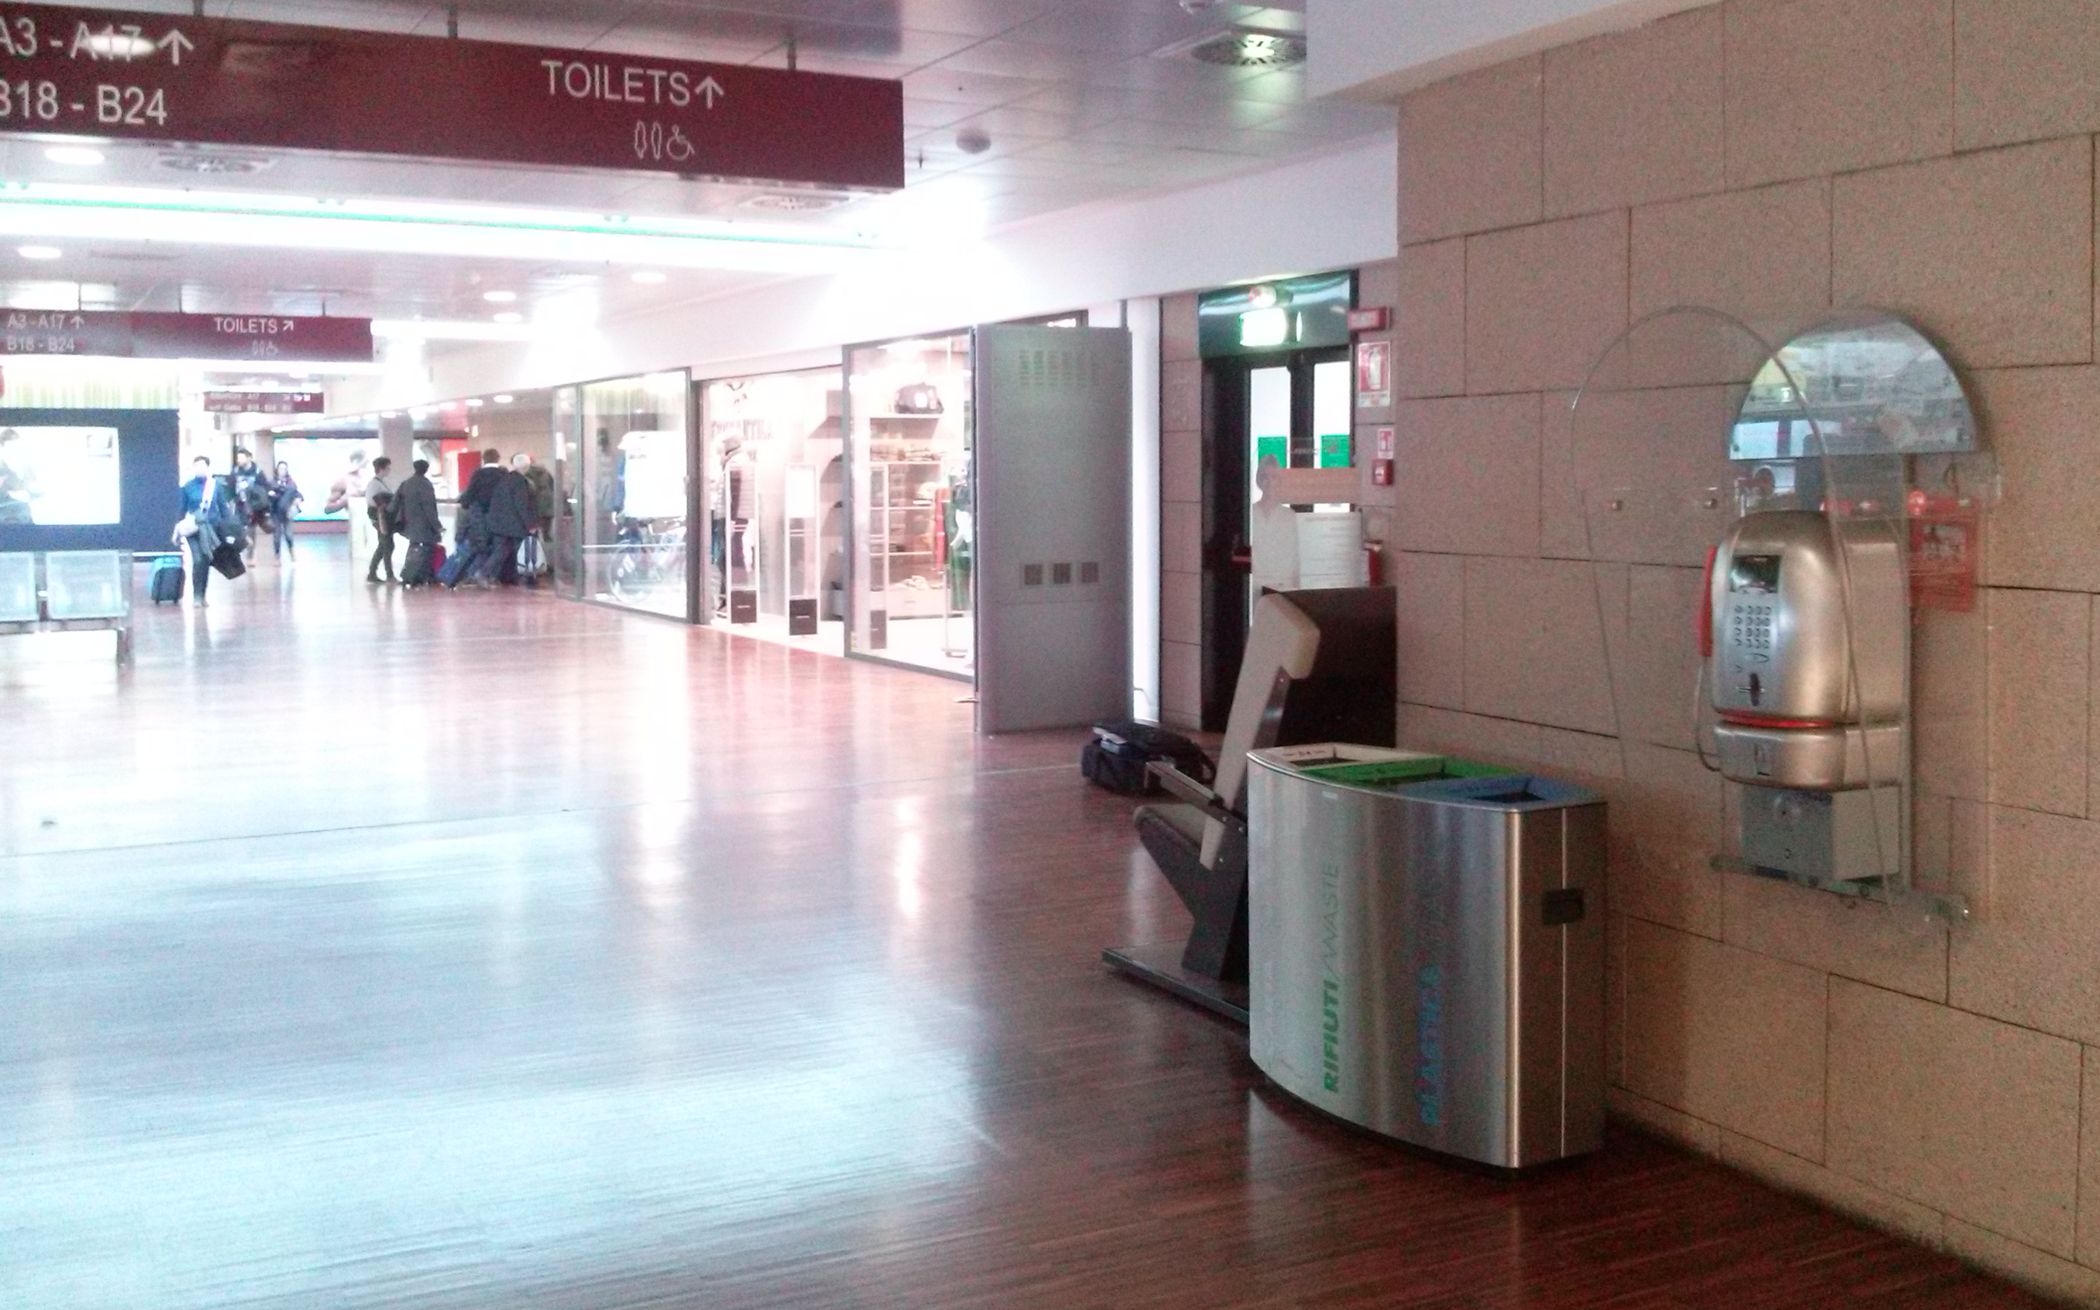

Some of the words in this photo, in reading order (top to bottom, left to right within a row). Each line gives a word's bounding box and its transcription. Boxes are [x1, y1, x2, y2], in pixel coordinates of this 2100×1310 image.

[70, 21, 142, 61] A17
[541, 60, 690, 106] TOILETS
[97, 85, 168, 126] B24
[7, 312, 26, 329] A3
[39, 314, 65, 329] A17
[213, 317, 278, 333] TOILETS
[48, 336, 75, 352] B24
